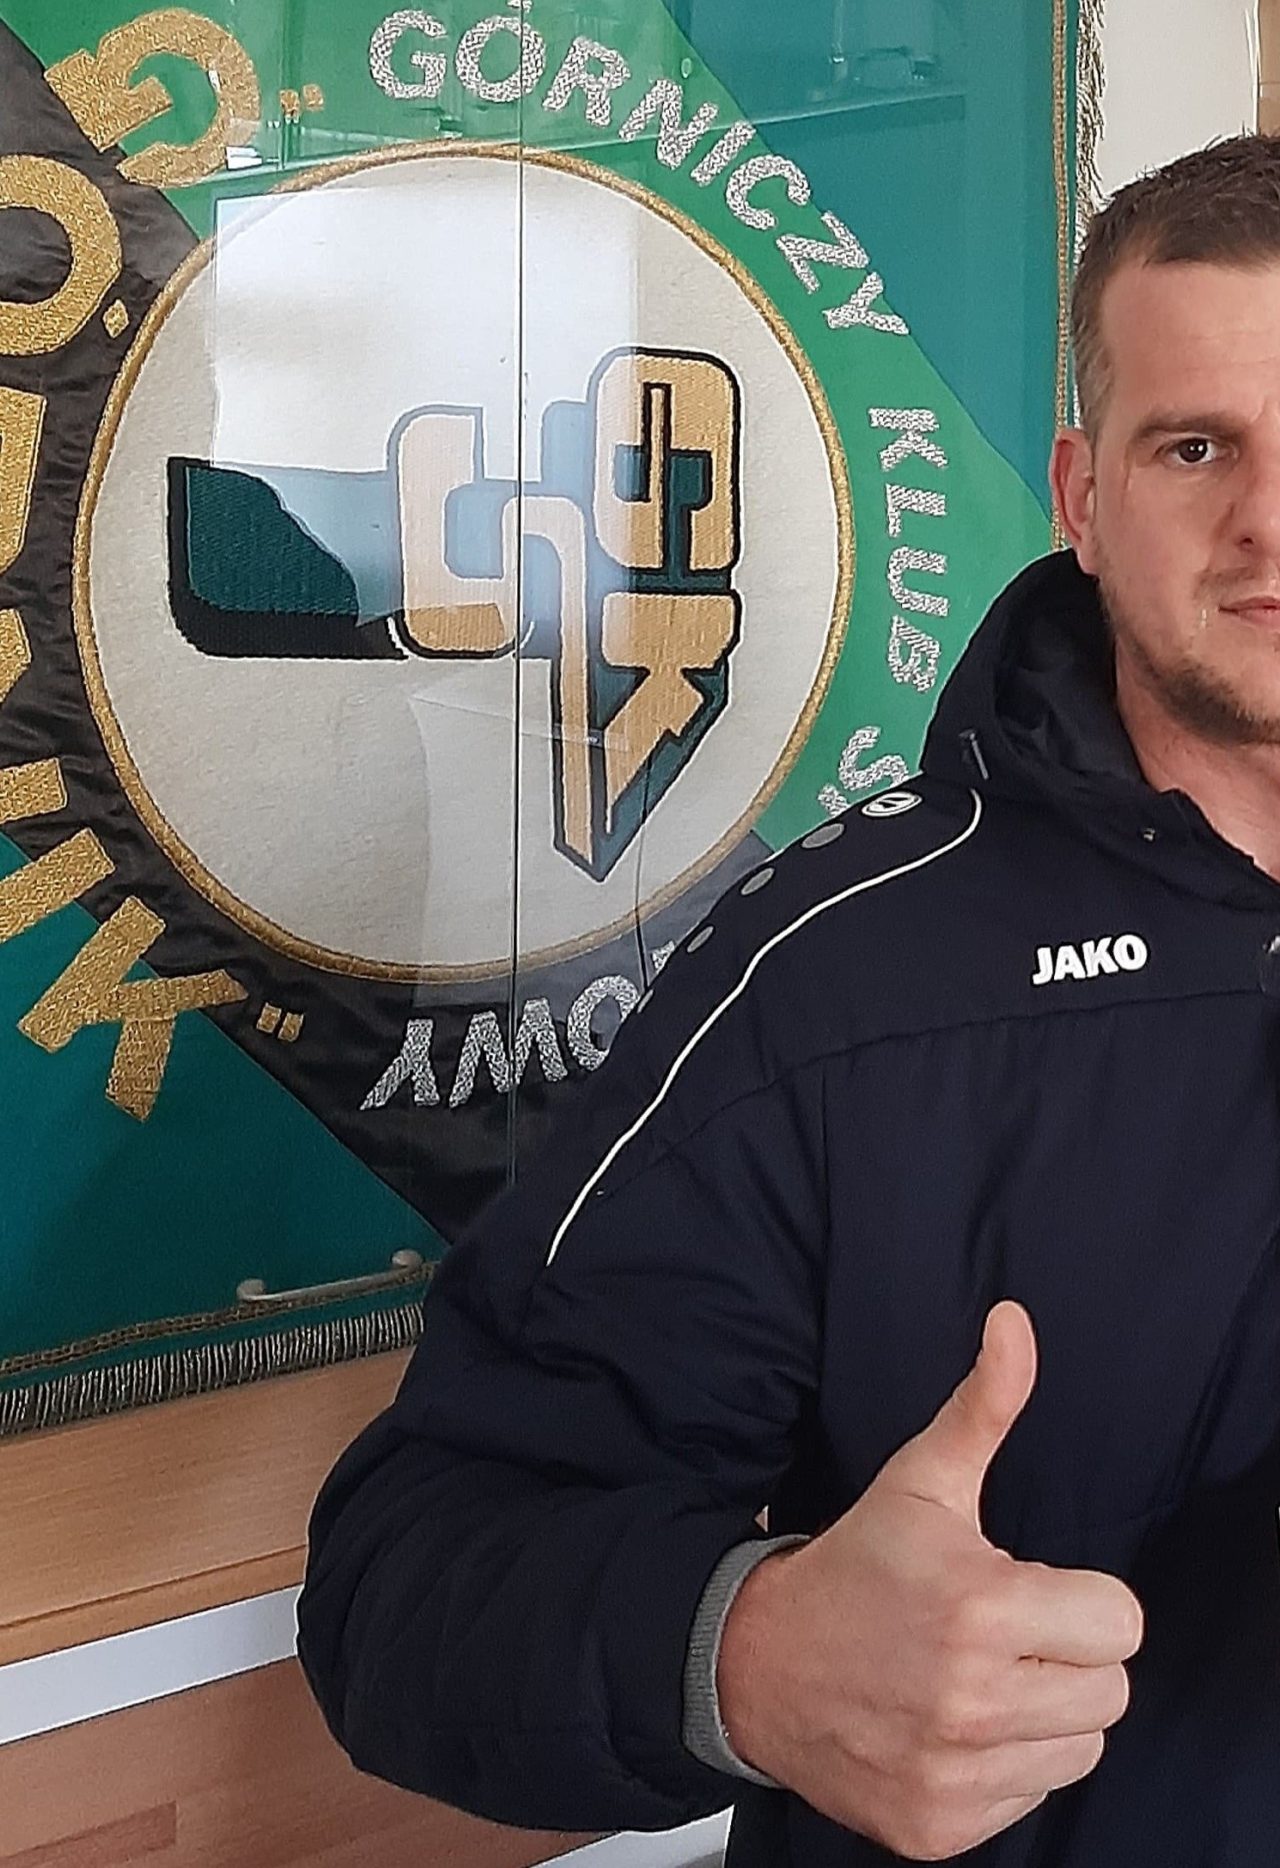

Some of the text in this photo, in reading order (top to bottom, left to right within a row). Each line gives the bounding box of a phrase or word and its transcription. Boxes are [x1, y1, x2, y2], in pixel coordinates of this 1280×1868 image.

[367, 0, 909, 335] GÓRNICZY
[869, 408, 948, 692] KLUB
[1032, 934, 1148, 985] JAKO
